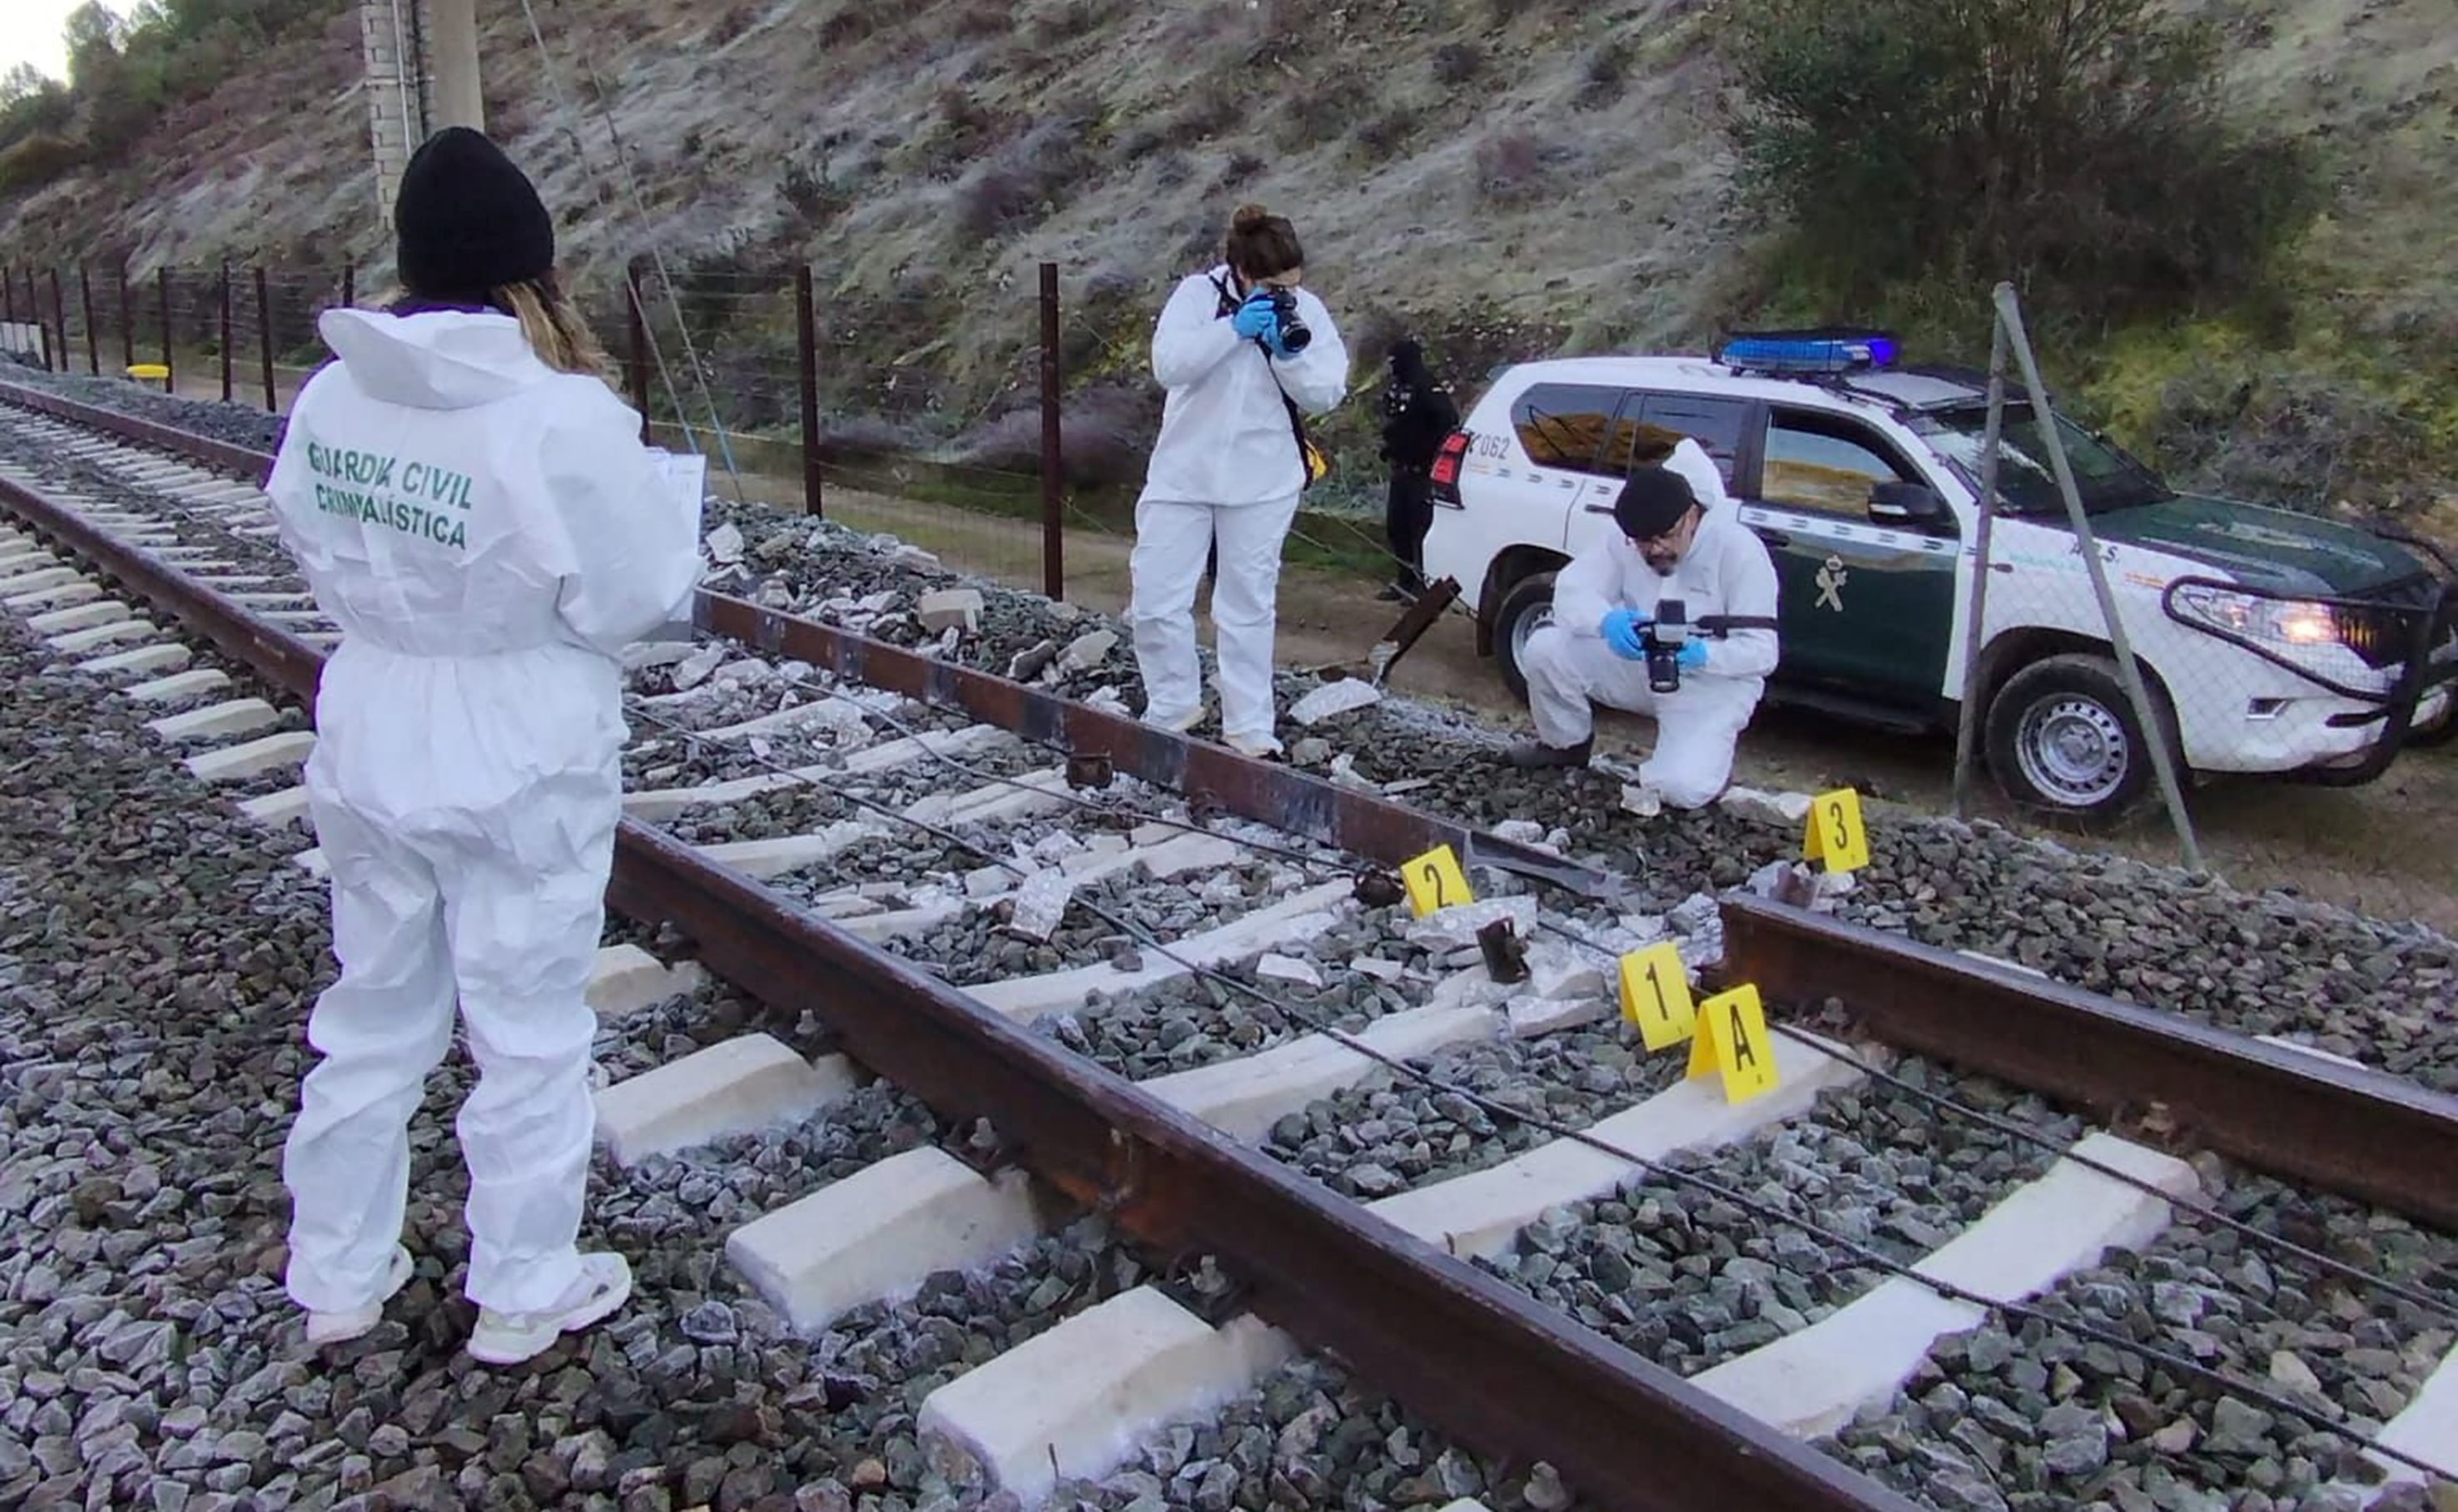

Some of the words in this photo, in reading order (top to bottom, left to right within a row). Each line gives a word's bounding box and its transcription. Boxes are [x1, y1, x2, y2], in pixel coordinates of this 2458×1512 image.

[1479, 434, 1511, 459] 062
[402, 462, 472, 509] CIVIL
[1830, 801, 1848, 850] 3
[1423, 863, 1453, 908] 2
[1646, 961, 1669, 1021] 1
[1730, 1004, 1756, 1072] A
